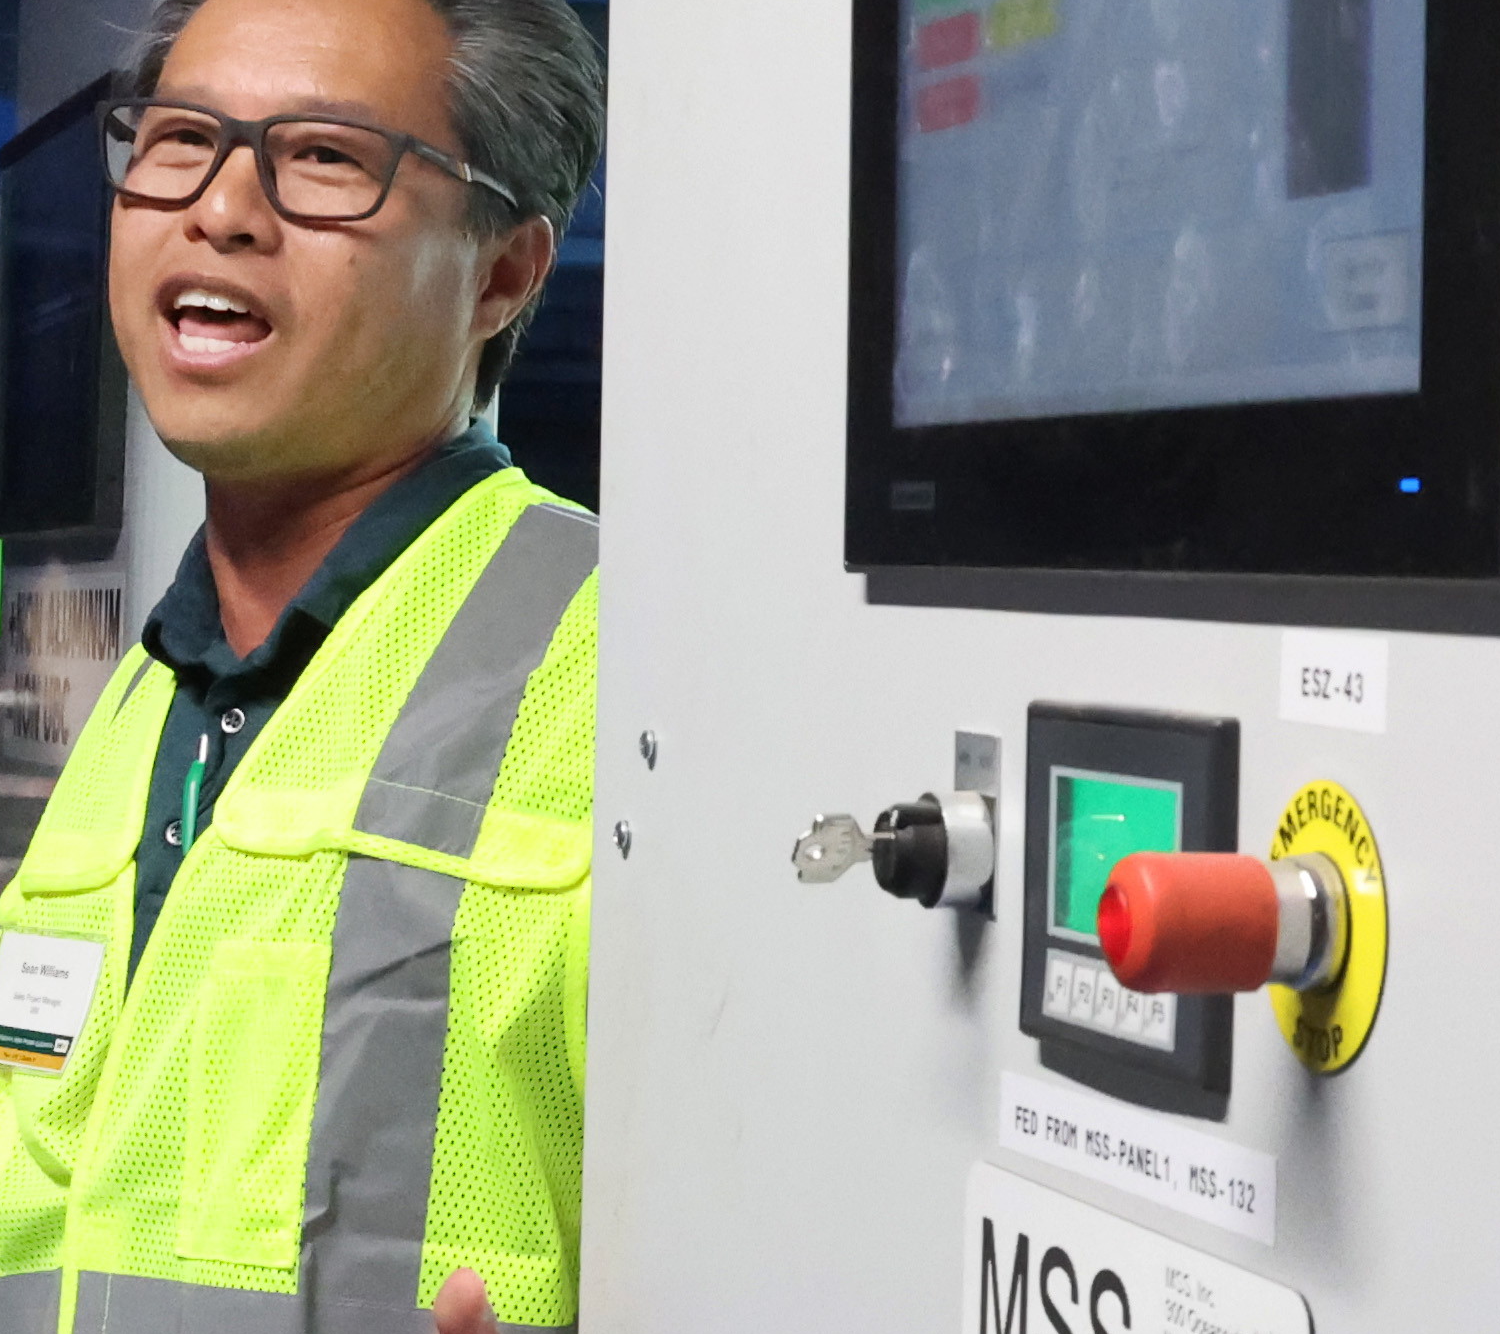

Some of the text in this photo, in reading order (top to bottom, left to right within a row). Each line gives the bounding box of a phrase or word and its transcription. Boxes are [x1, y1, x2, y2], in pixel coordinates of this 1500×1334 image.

[1301, 667, 1365, 705] ESZ-43
[1270, 786, 1379, 882] EMERGENCY
[1292, 1017, 1344, 1064] STOP
[1014, 1105, 1039, 1134] FED
[1046, 1114, 1079, 1148] FROM
[1188, 1164, 1256, 1216] MSS-132
